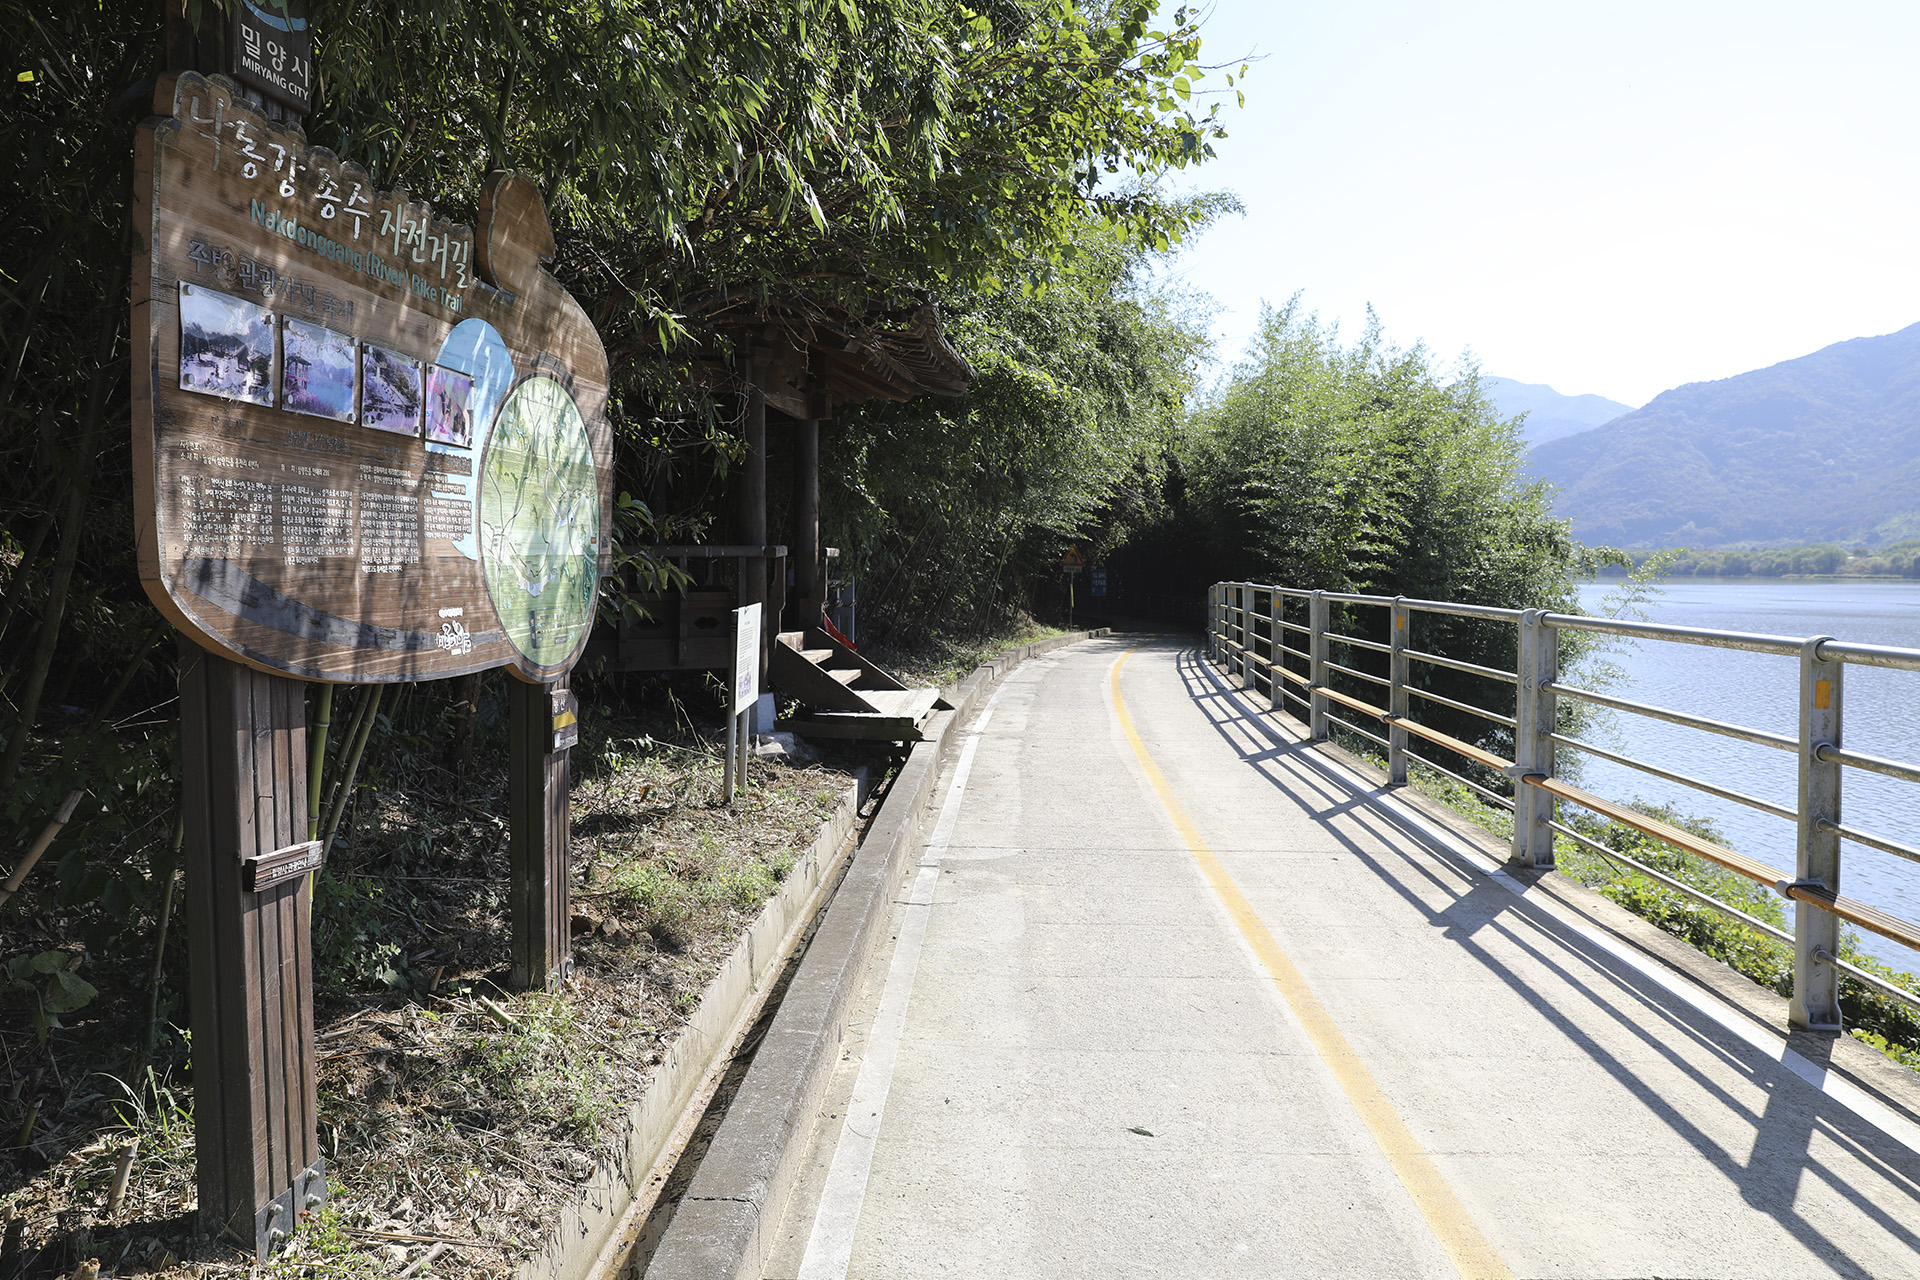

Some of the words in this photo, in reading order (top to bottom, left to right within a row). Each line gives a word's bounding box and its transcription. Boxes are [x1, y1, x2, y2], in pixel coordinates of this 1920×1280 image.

[240, 23, 309, 88] 밀양시
[242, 56, 287, 90] MIRYANG
[288, 82, 309, 101] CITY
[190, 94, 306, 199] 낙동강
[314, 166, 371, 241] 종주
[379, 203, 470, 289] 자전거길
[238, 260, 295, 304] 관광지
[251, 198, 363, 272] Nakdonggang
[366, 253, 410, 292] (River)
[412, 273, 437, 304] Bike
[439, 286, 464, 313] Trail
